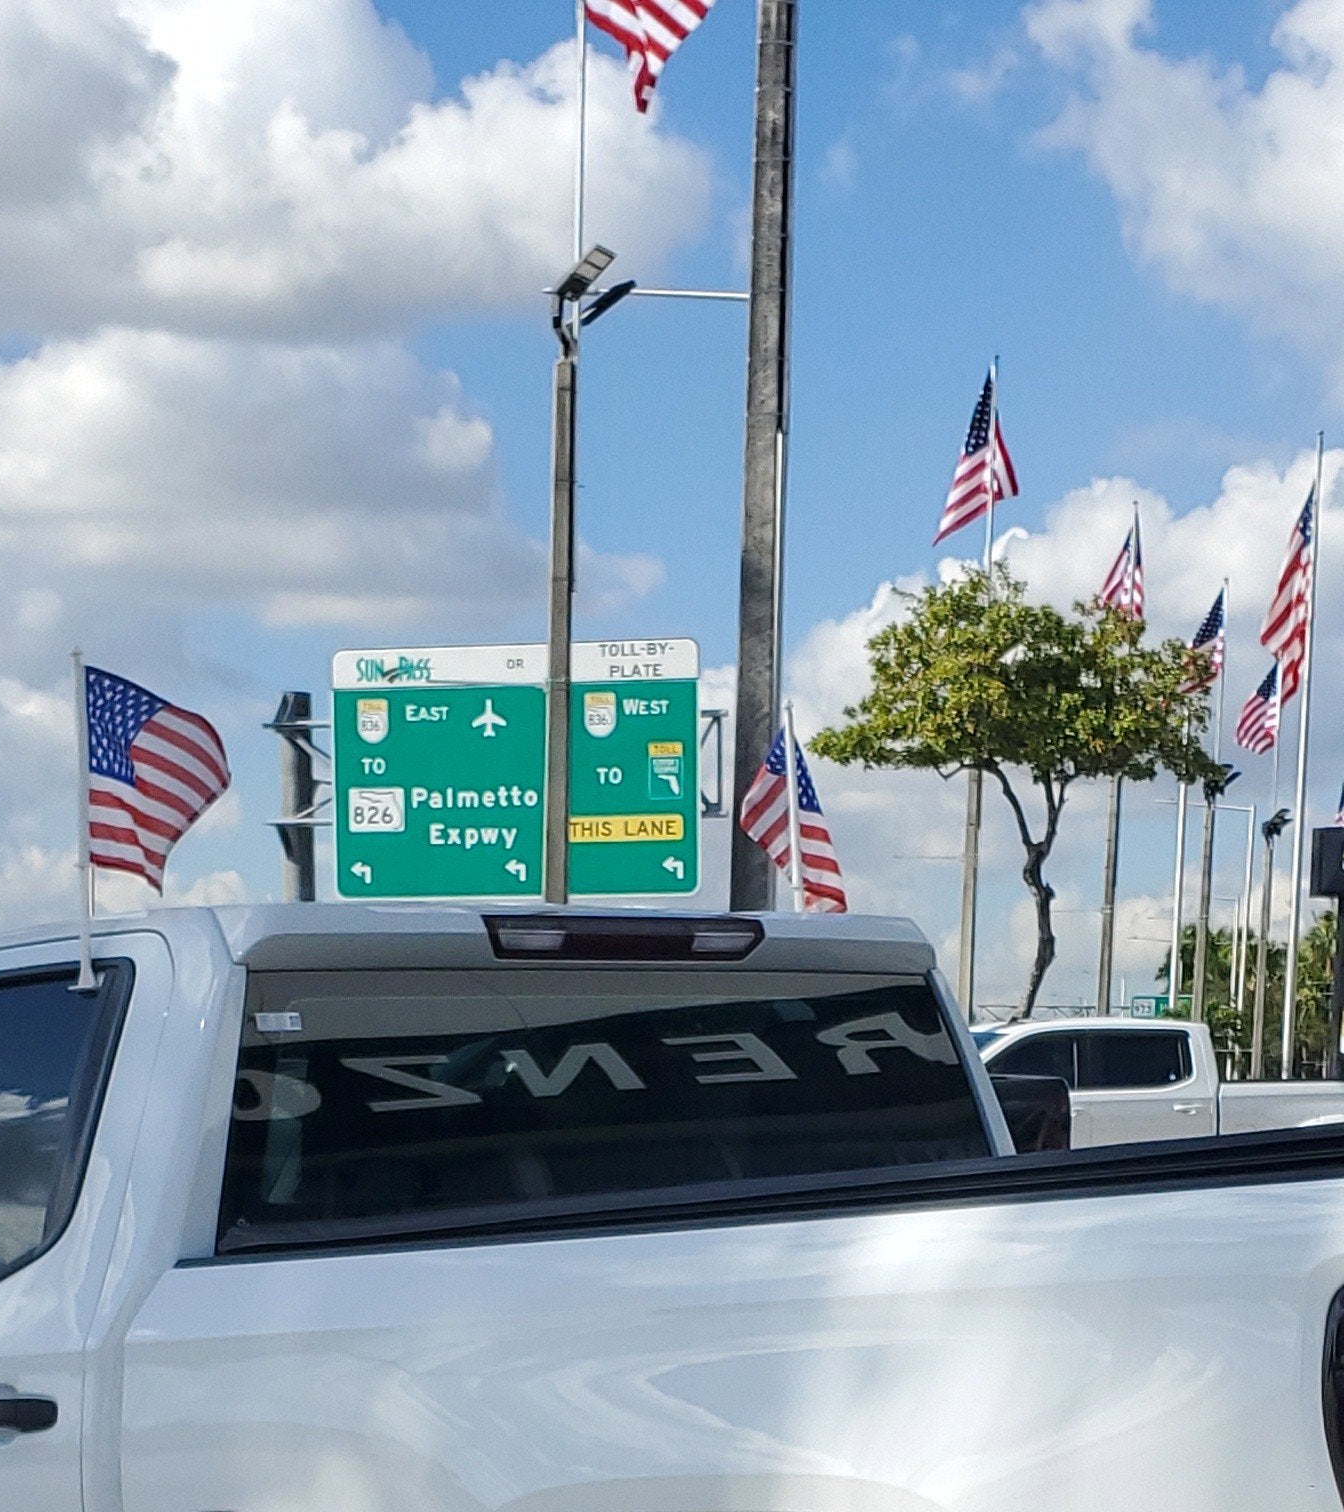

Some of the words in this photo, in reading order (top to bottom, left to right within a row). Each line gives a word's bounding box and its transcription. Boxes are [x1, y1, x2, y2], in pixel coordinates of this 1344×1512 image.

[506, 658, 524, 670] OR
[609, 663, 663, 679] PLATE
[405, 704, 449, 722] EAST
[622, 698, 670, 716] WEST
[361, 757, 387, 775] TO
[596, 766, 623, 785] TO
[410, 785, 538, 809] Palmetto
[353, 805, 394, 825] 826
[428, 822, 517, 850] Expwy
[570, 821, 613, 838] THIS
[624, 819, 677, 837] LANE
